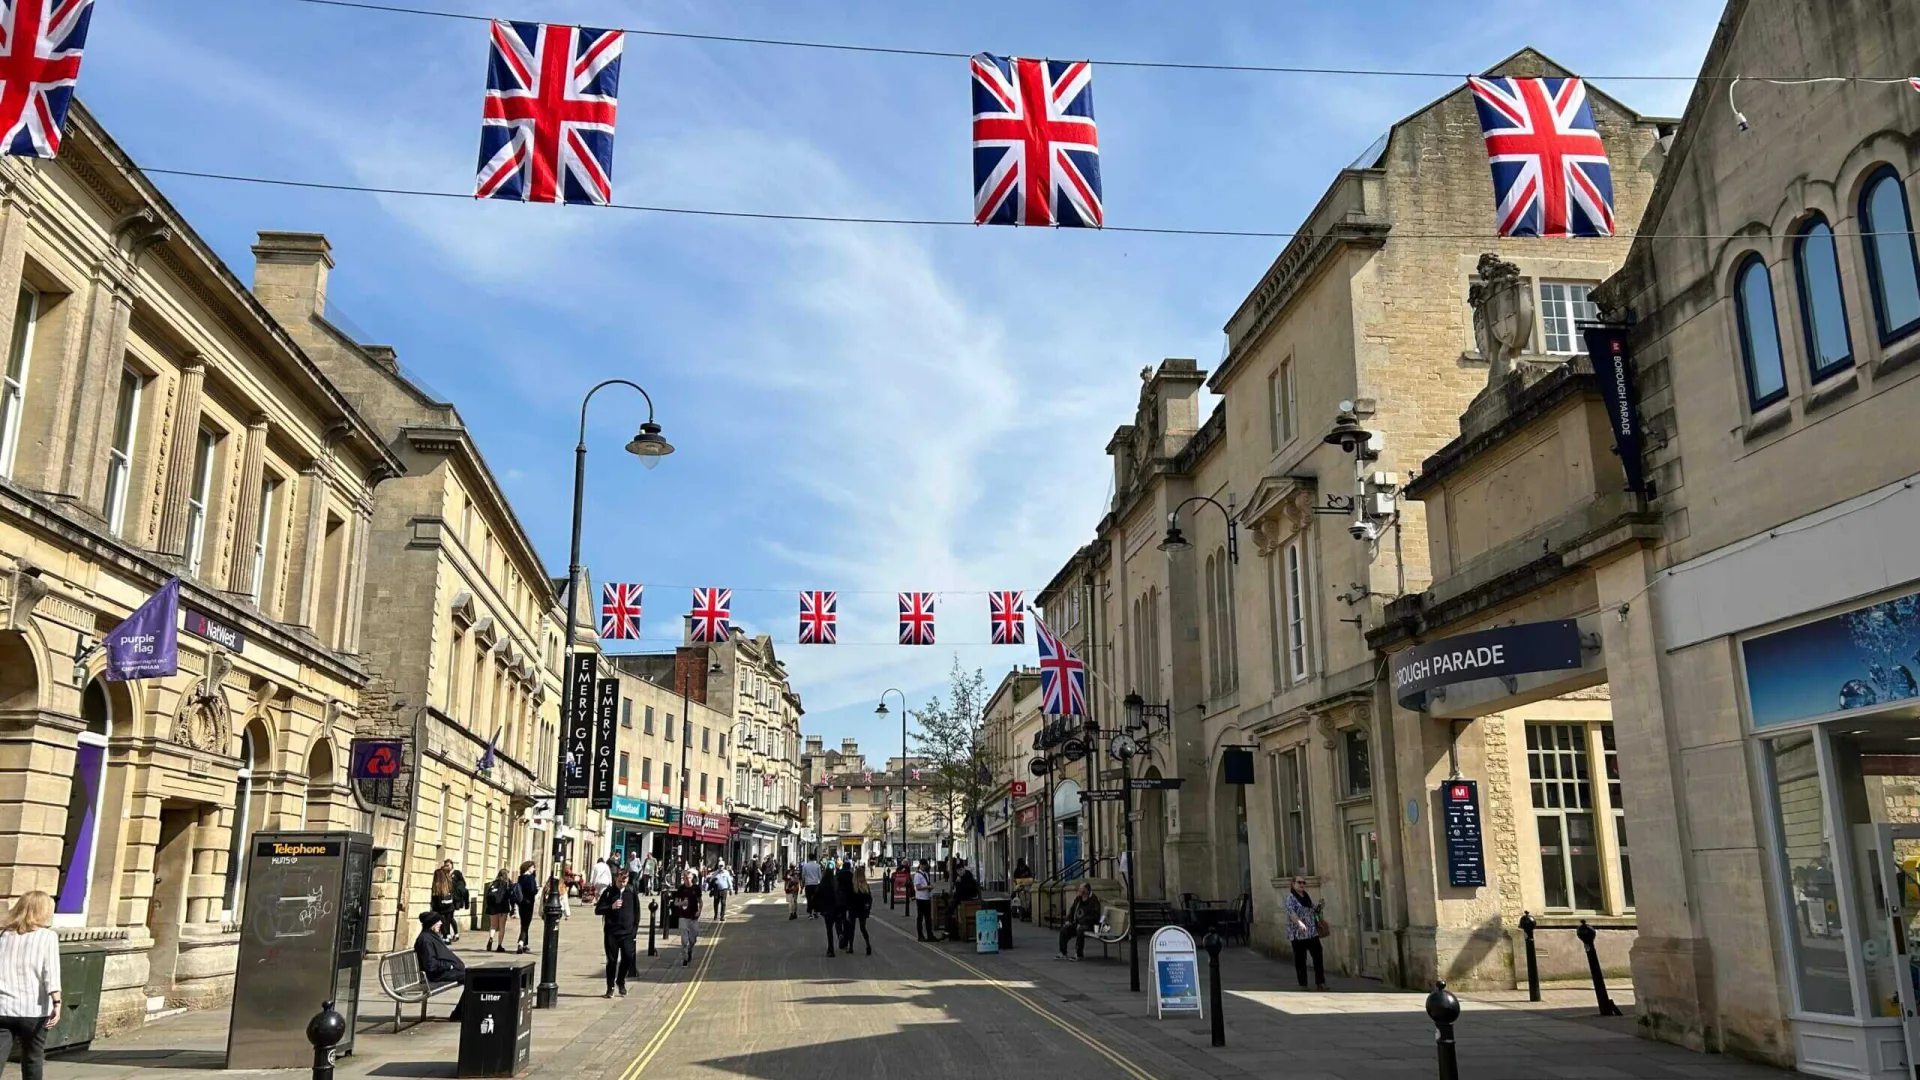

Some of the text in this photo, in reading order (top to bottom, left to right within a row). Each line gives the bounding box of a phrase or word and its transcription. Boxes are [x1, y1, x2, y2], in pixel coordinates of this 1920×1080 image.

[1614, 356, 1626, 399] BOROUGH
[1620, 401, 1631, 435] PARADE
[120, 634, 155, 645] purple
[134, 642, 154, 654] flag
[206, 620, 236, 648] NatWest
[1433, 644, 1505, 675] PARADE
[574, 659, 591, 778] EMERY GATE
[600, 684, 614, 792] EMERY GATE
[273, 843, 327, 856] Telephone
[480, 993, 501, 1001] Litter
